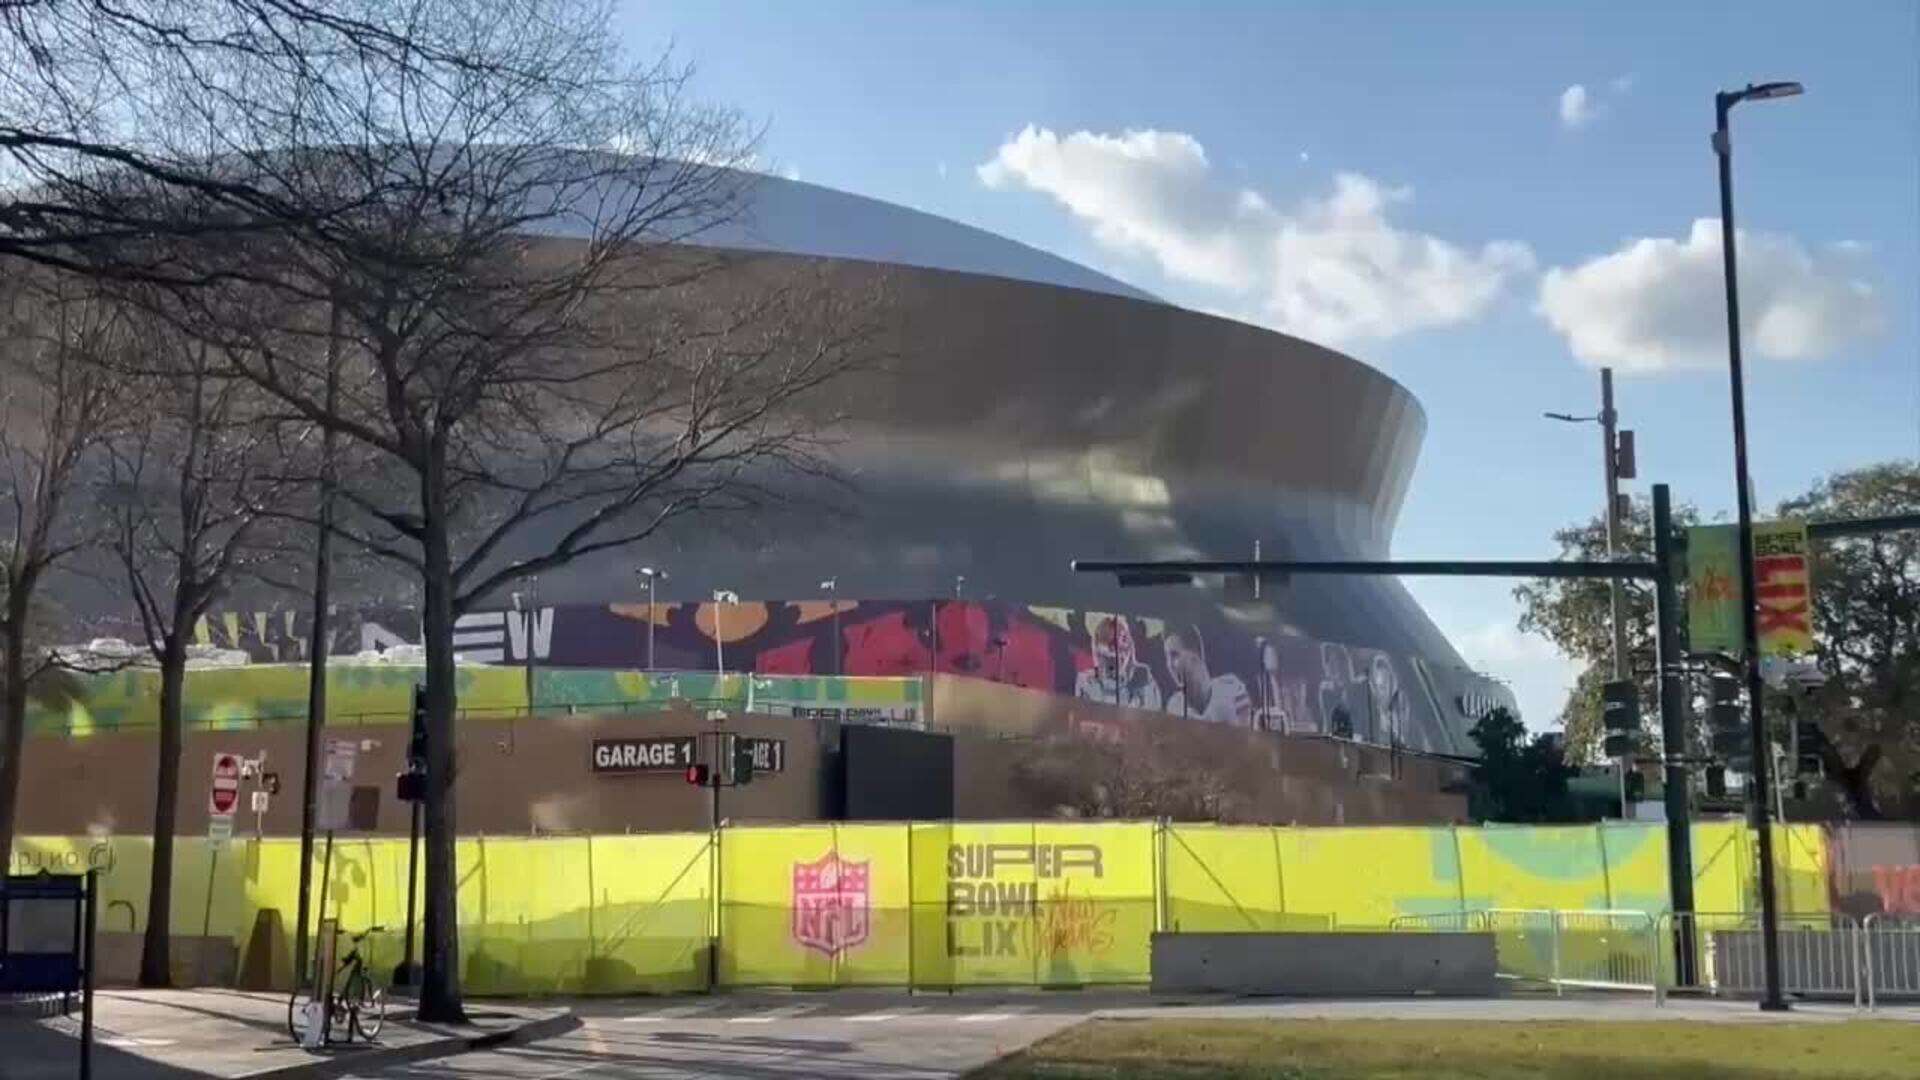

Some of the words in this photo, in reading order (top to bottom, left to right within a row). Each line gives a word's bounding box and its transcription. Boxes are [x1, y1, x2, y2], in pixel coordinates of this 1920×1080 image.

[595, 743, 676, 768] GARAGE
[681, 742, 692, 764] 1
[773, 742, 781, 770] 1
[946, 843, 1104, 879] SUPER
[946, 881, 1045, 916] BOWL
[800, 896, 868, 941] NFL
[946, 920, 1018, 958] LIX
